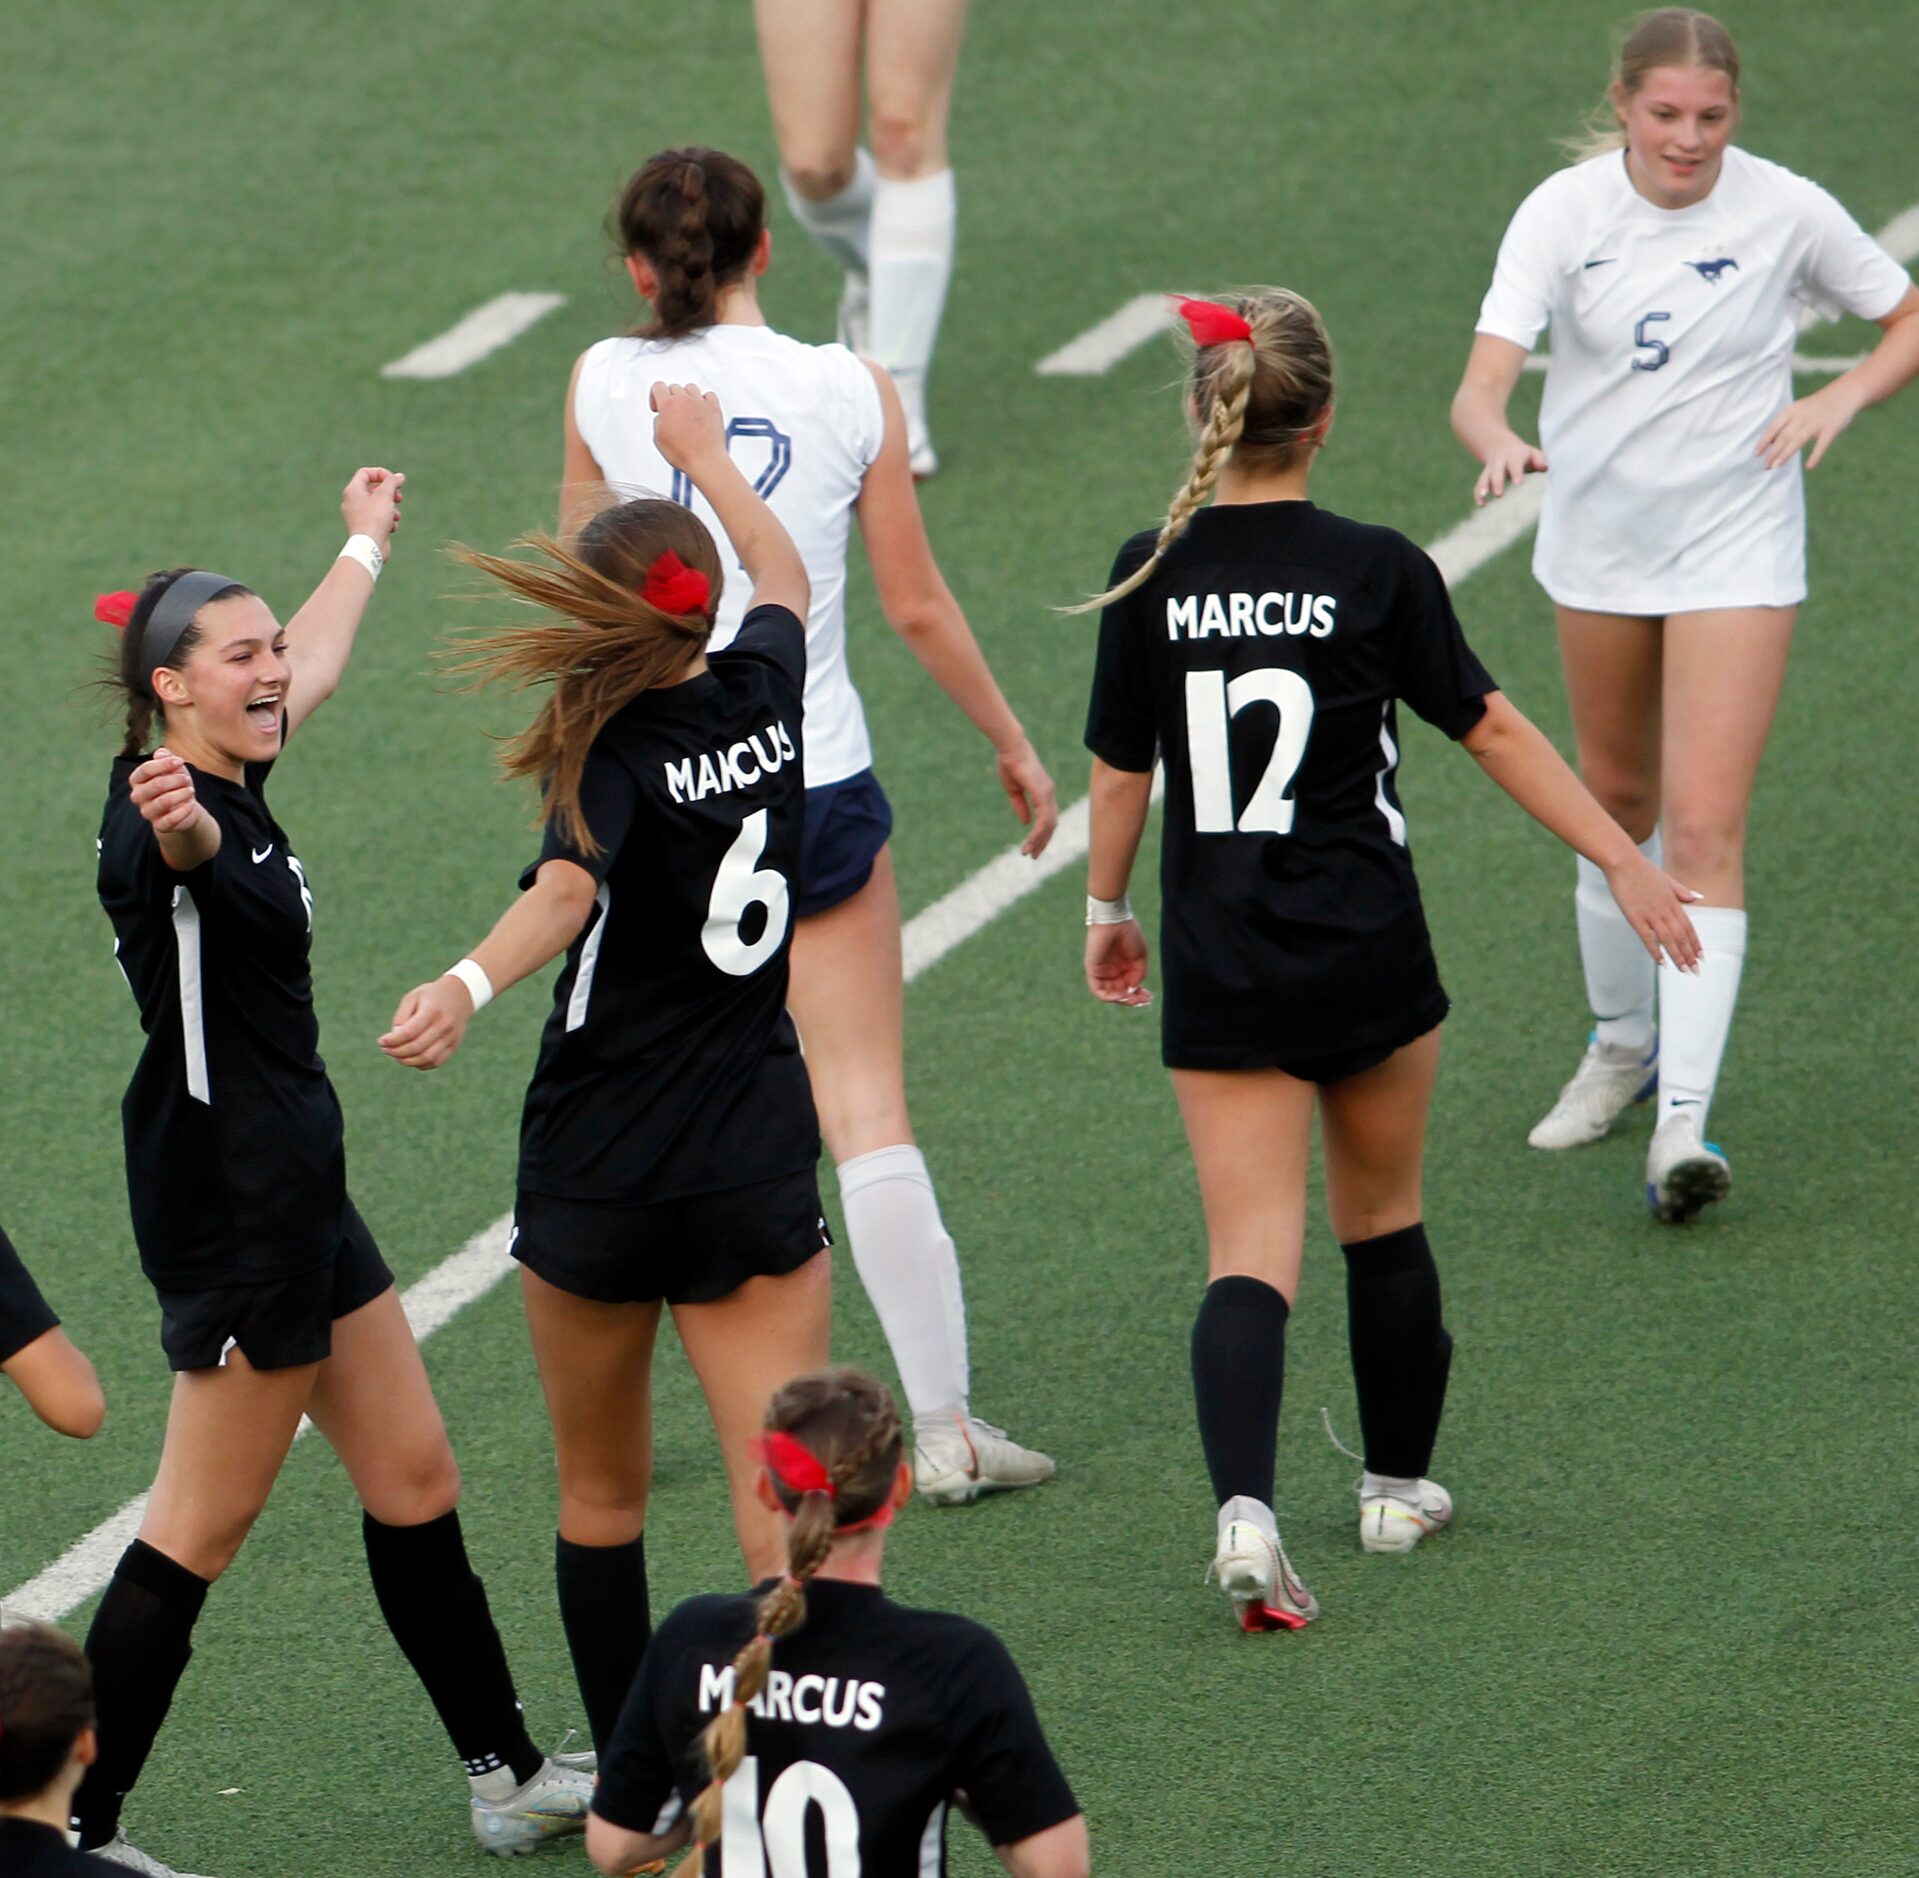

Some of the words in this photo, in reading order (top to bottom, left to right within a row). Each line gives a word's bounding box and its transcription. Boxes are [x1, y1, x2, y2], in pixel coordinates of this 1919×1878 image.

[1632, 312, 1671, 371] 5
[1166, 592, 1337, 641] MARCUS
[1185, 668, 1315, 835] 12
[701, 808, 790, 976] 6
[721, 1755, 861, 1878] 10
